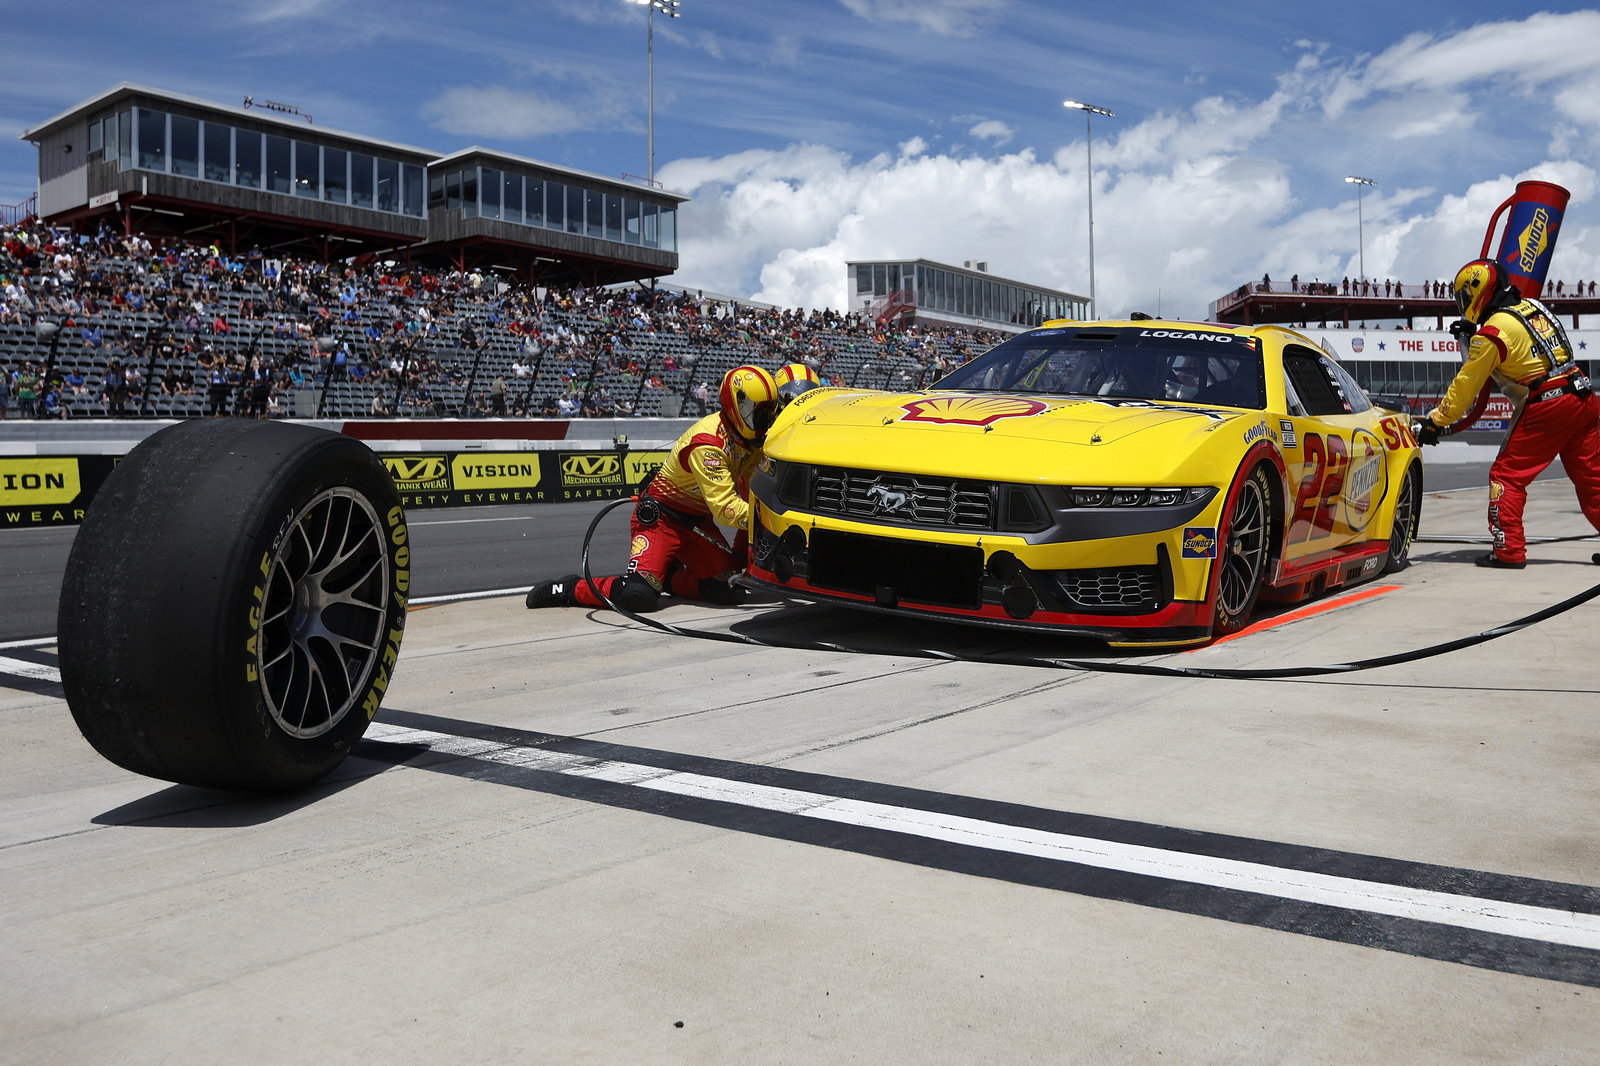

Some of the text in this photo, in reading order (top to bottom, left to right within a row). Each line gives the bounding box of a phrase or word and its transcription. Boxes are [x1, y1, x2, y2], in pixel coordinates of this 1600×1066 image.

[1520, 209, 1547, 272] SUNOCO
[1139, 330, 1233, 343] LOGANO
[1398, 340, 1461, 352] THE LEGE
[1472, 420, 1502, 429] GEICO
[1243, 420, 1278, 444] GOODYEAR
[1379, 416, 1417, 450] Sh
[462, 464, 532, 478] VISION
[1350, 454, 1381, 499] PENNZOIL
[3, 473, 65, 490] ION
[422, 479, 448, 490] WEAR
[563, 474, 622, 485] MECHANIX WEAR
[564, 489, 623, 499] SAFETY
[1289, 432, 1349, 545] 22
[402, 491, 545, 506] FETY EYEWEAR
[6, 509, 85, 523] WEAR
[1184, 538, 1215, 549] SUNOCO
[1363, 557, 1378, 571] FORD
[552, 584, 564, 594] N
[247, 551, 272, 682] EAGLE
[361, 505, 410, 721] GOODYEAR
